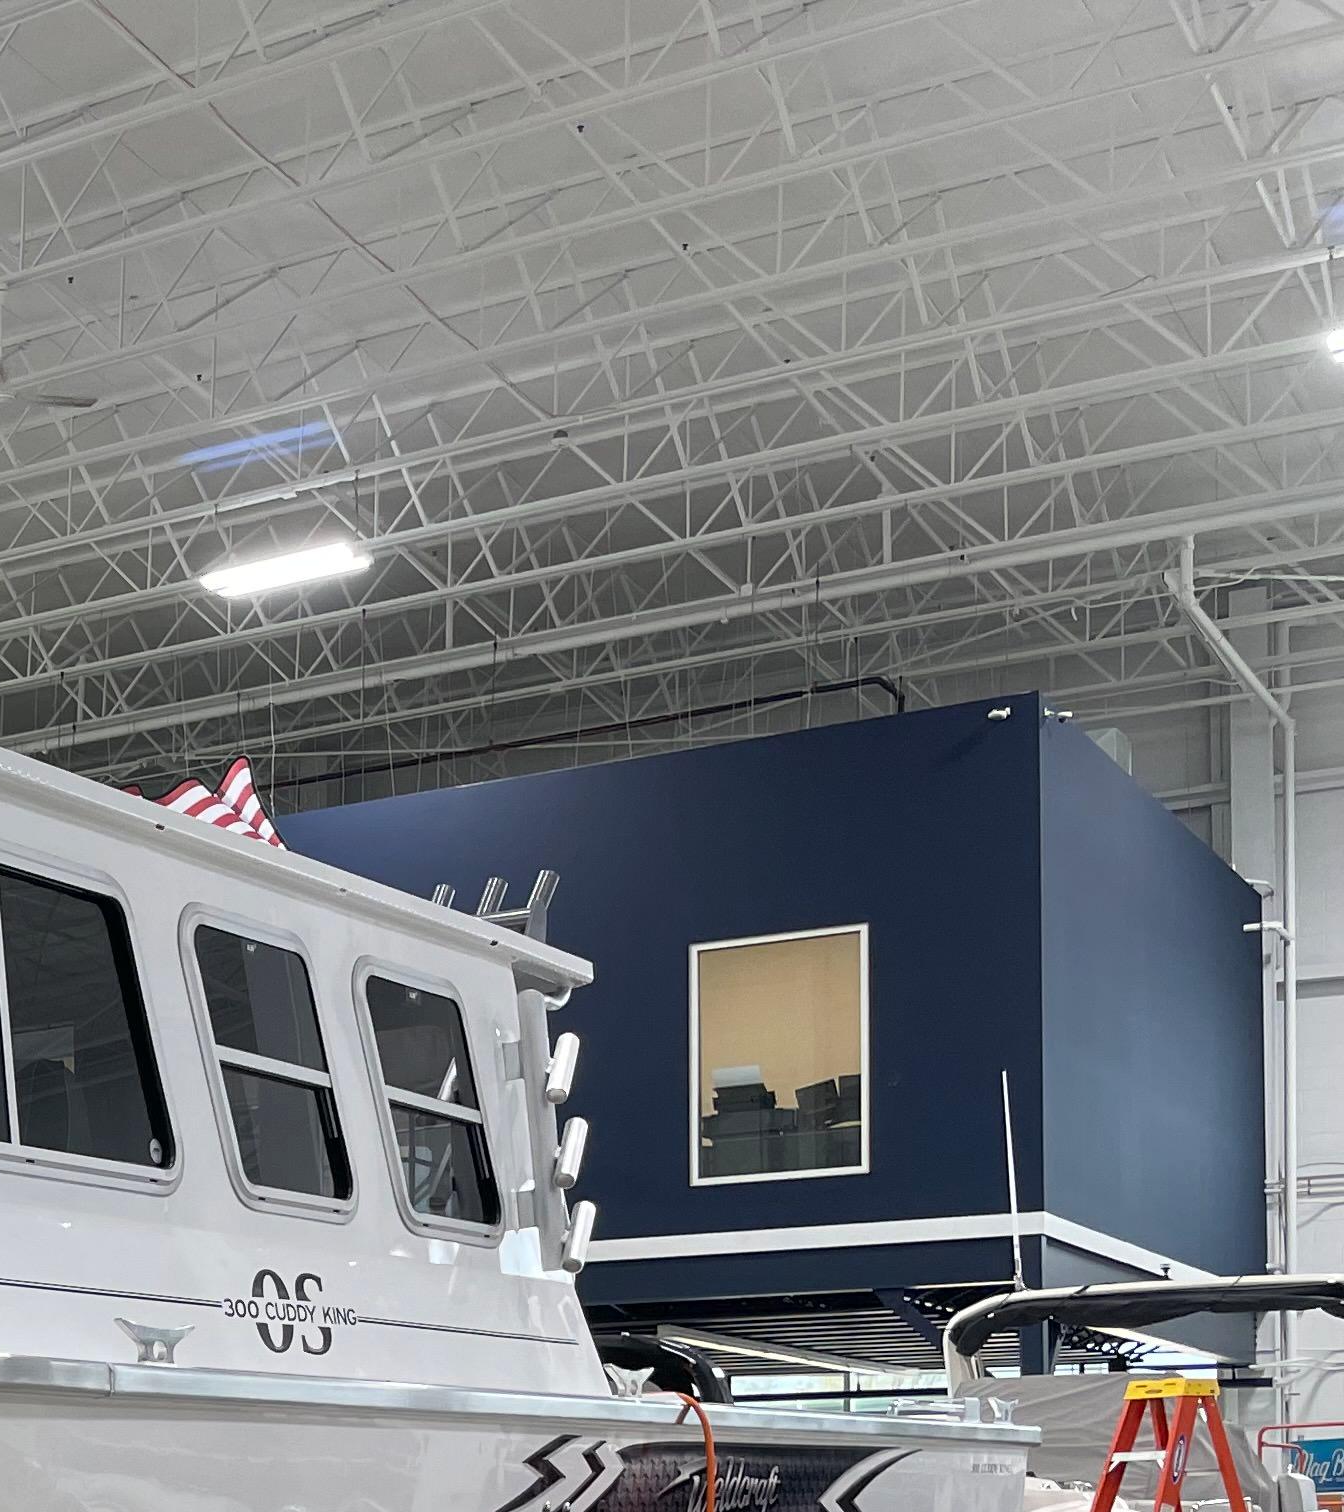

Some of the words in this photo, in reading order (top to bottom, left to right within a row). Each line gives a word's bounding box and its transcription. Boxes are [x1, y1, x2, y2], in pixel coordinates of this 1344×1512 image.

[223, 1298, 260, 1319] 300
[265, 1302, 317, 1323] CUDDY
[322, 1306, 358, 1326] KING
[252, 1269, 332, 1355] OS
